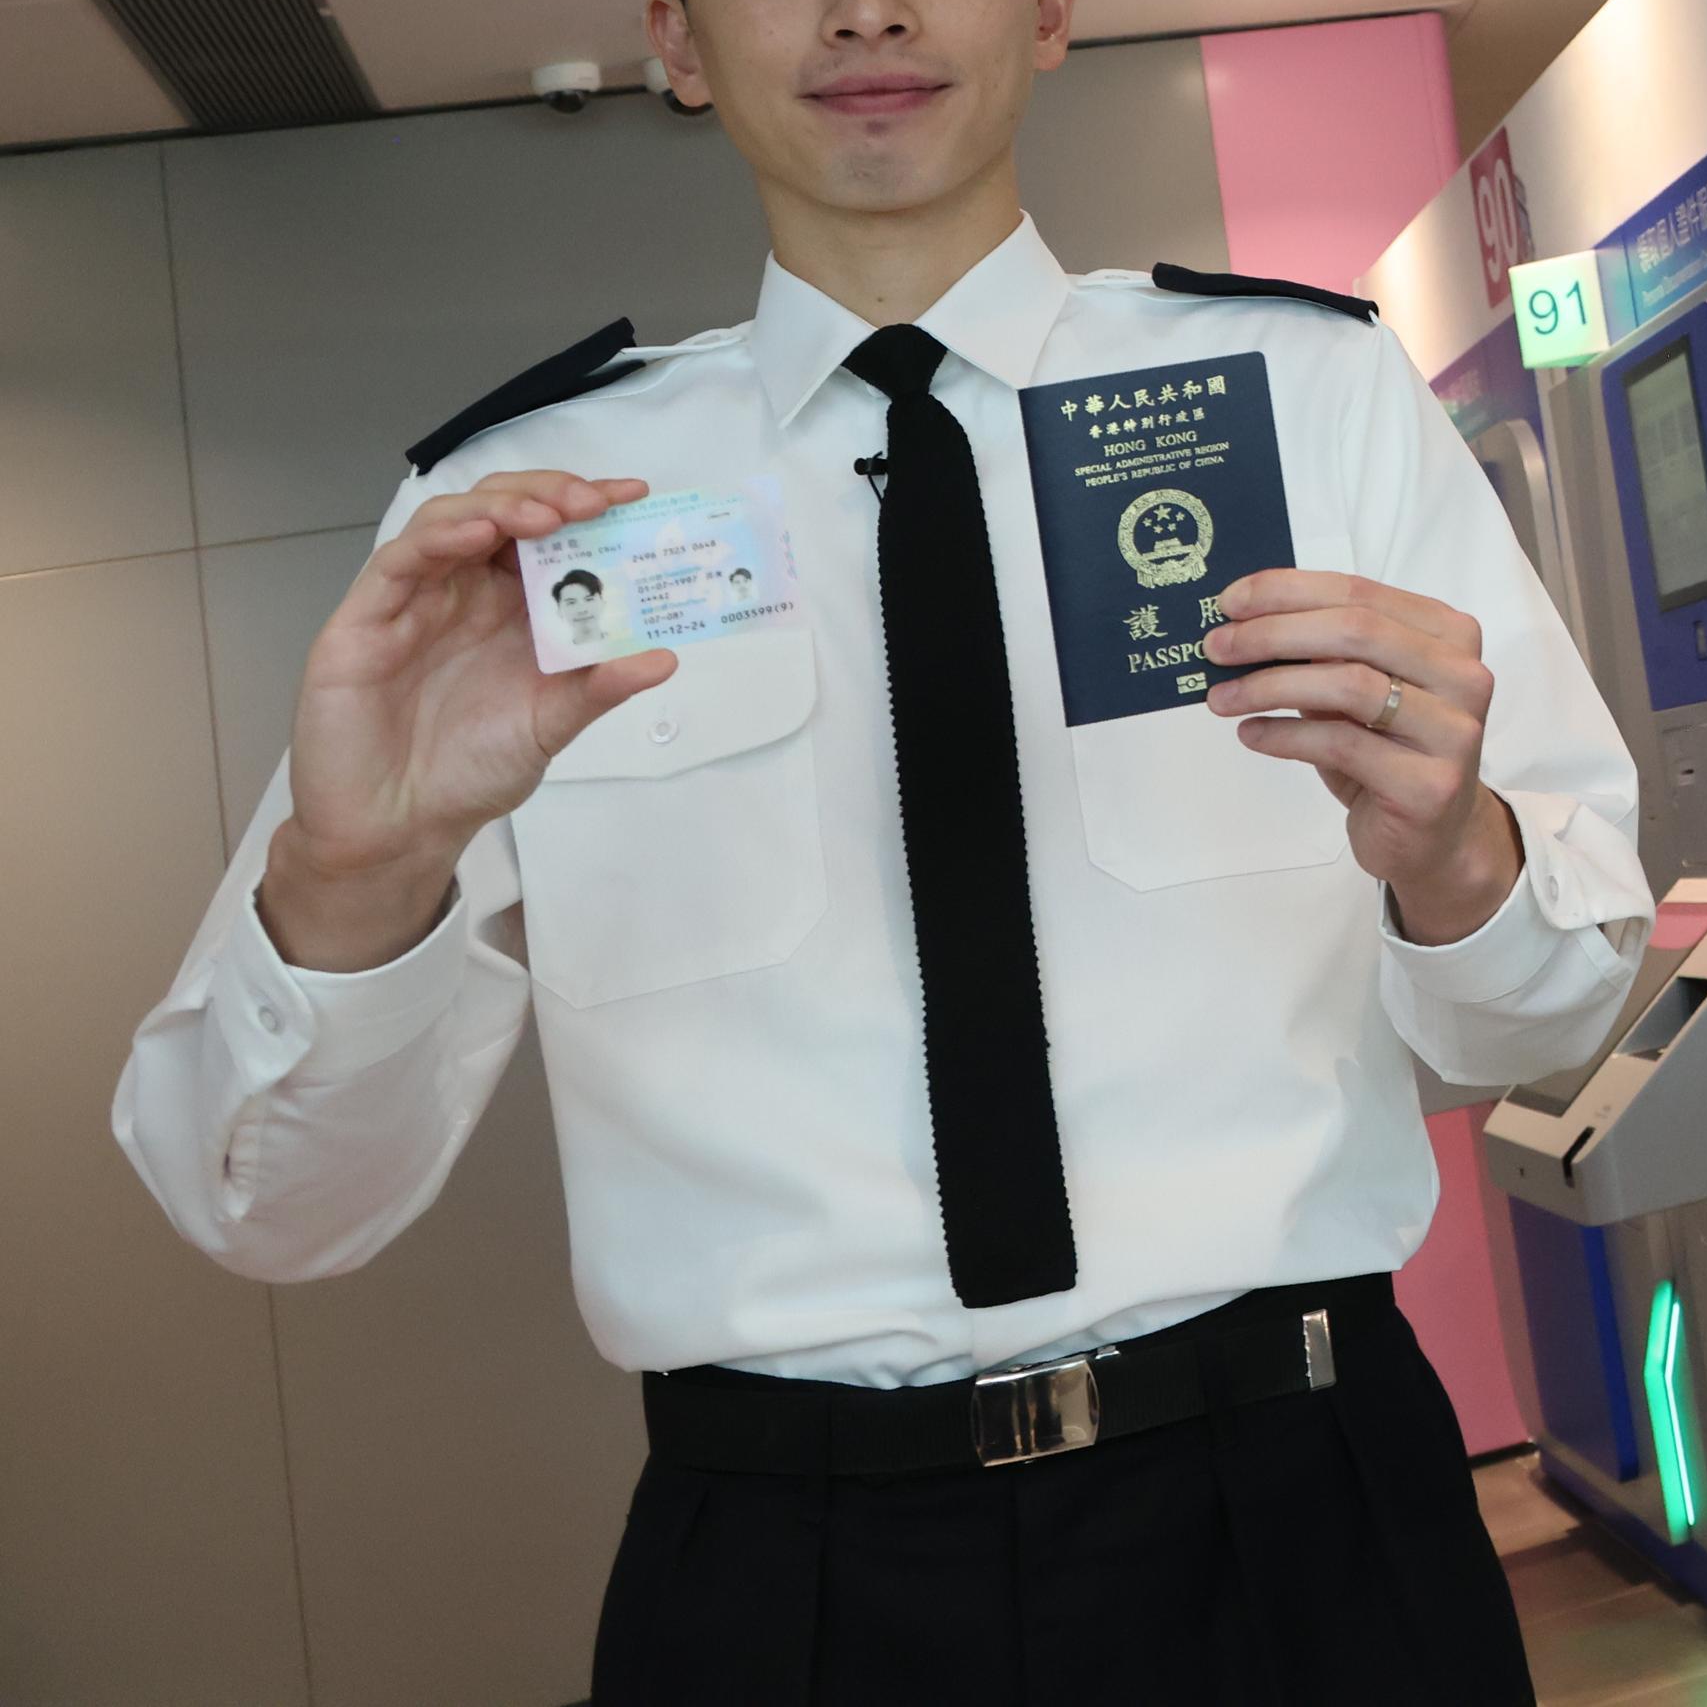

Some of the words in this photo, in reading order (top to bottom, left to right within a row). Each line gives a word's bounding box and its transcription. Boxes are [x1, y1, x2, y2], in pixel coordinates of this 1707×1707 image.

[1478, 158, 1519, 282] 90
[1528, 280, 1588, 335] 91
[1060, 375, 1228, 422] 中華人民共和國
[1089, 407, 1205, 439] 香港特別行政區
[1074, 462, 1113, 476] SPECIAL
[1115, 448, 1193, 469] ADMINISTRATIVE
[1194, 441, 1230, 454] REGION
[1104, 439, 1146, 457] HONG
[1155, 430, 1197, 448] KONG
[1085, 472, 1129, 487] PEOPLE'S
[1131, 464, 1177, 479] REPUBLIC
[1178, 460, 1192, 470] OF
[1194, 455, 1225, 470] CHINA
[1127, 640, 1207, 674] PASSPO
